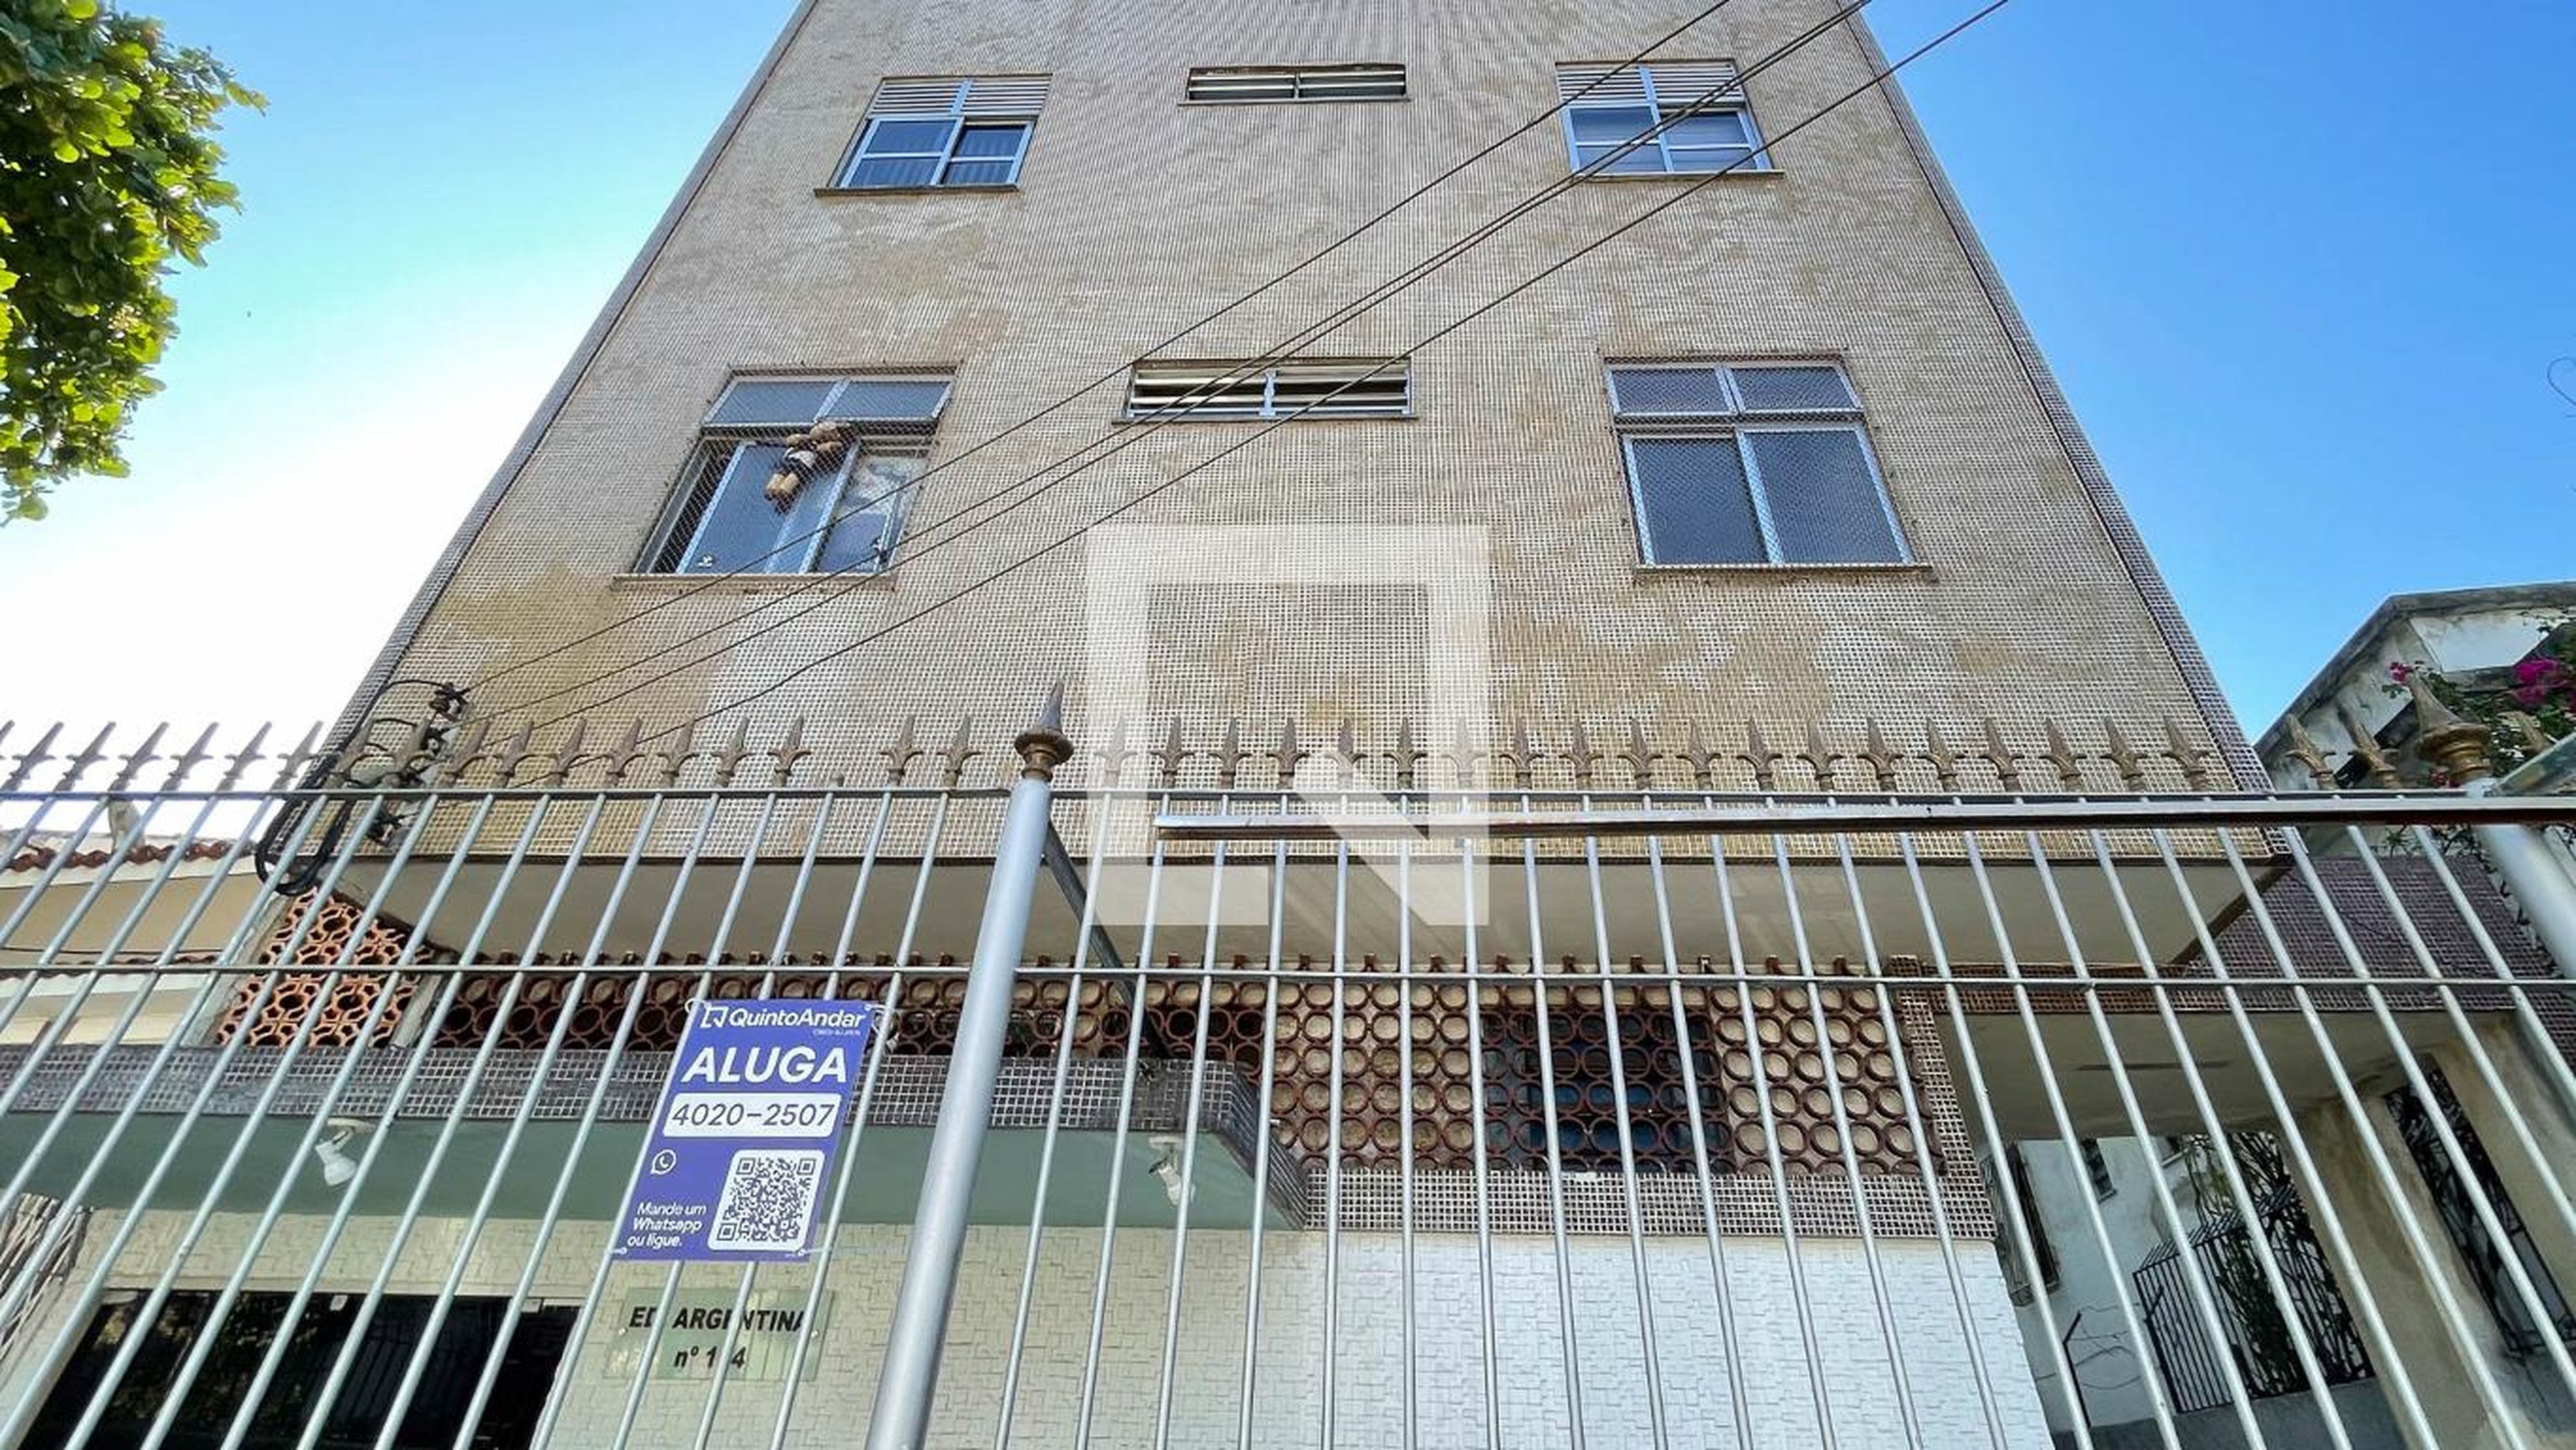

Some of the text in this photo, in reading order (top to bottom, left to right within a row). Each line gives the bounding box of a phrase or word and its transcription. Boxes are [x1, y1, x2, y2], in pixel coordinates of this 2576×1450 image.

[729, 1008, 867, 1027] QuintoAndar
[681, 1046, 847, 1083] ALUGA
[672, 1104, 835, 1126] 4020-2507
[685, 1206, 706, 1215] um
[633, 1217, 702, 1233] Whatsapp
[627, 1233, 682, 1249] ou ligue.
[706, 1345, 747, 1369] 14
